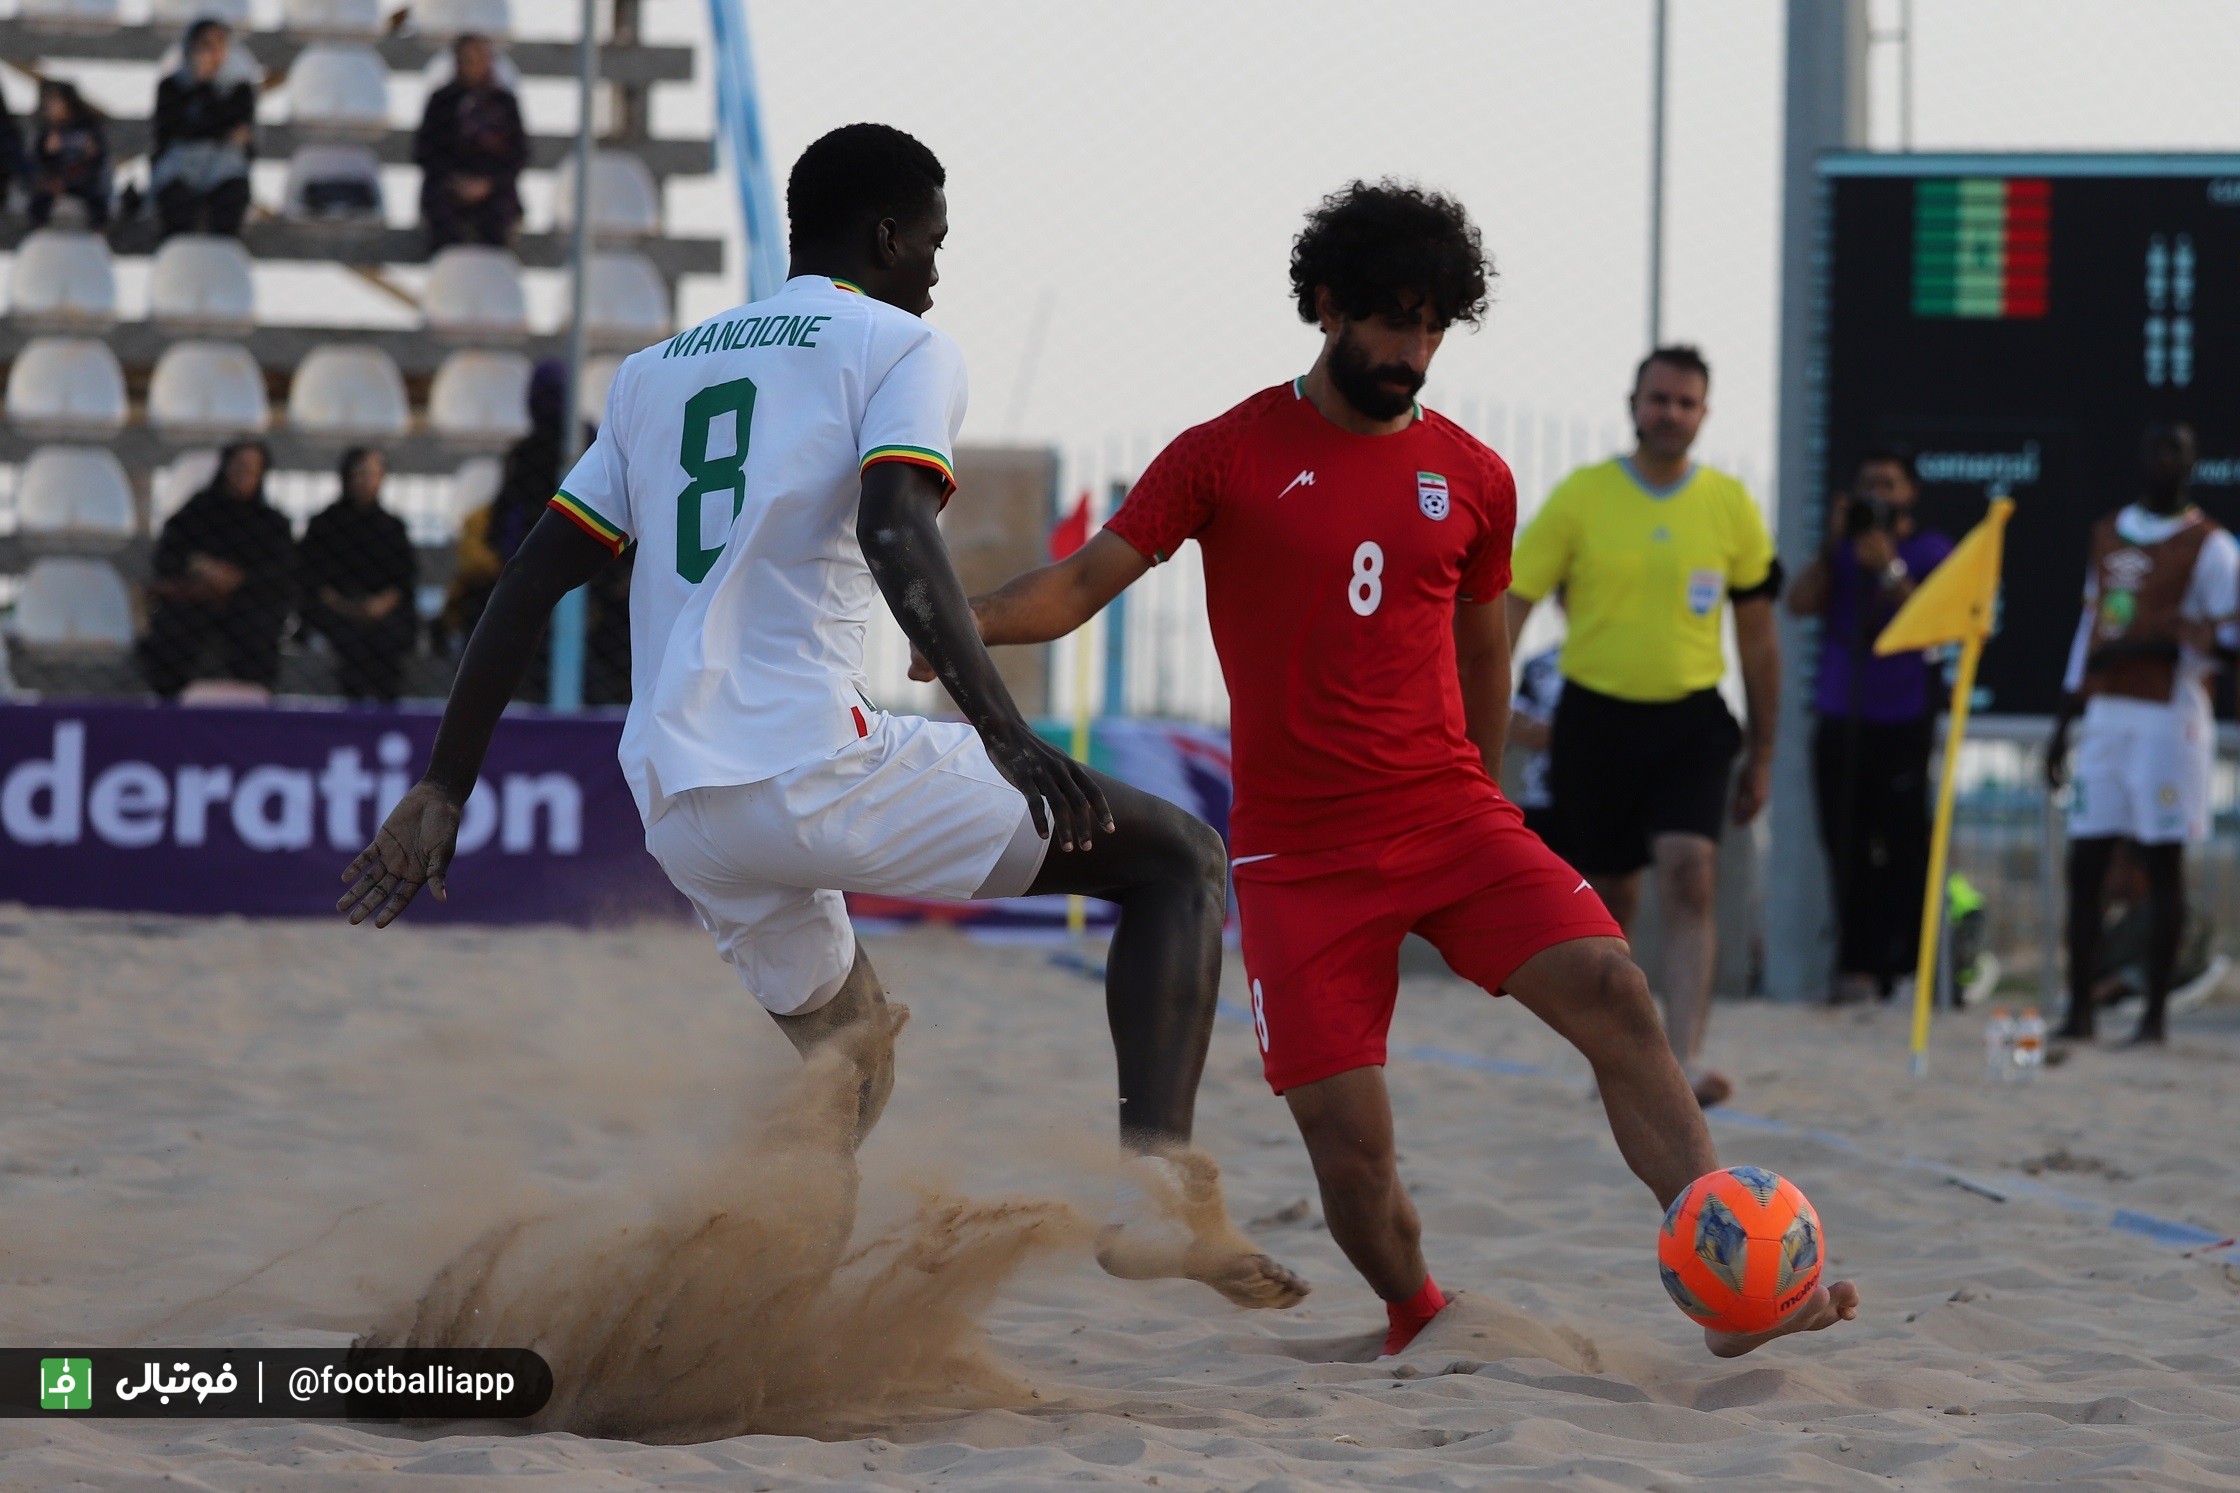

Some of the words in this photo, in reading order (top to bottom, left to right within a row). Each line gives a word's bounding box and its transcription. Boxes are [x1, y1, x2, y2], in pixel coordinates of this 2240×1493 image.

[662, 315, 833, 360] MANDIONE
[676, 376, 758, 585] 8
[1348, 540, 1384, 617] 8
